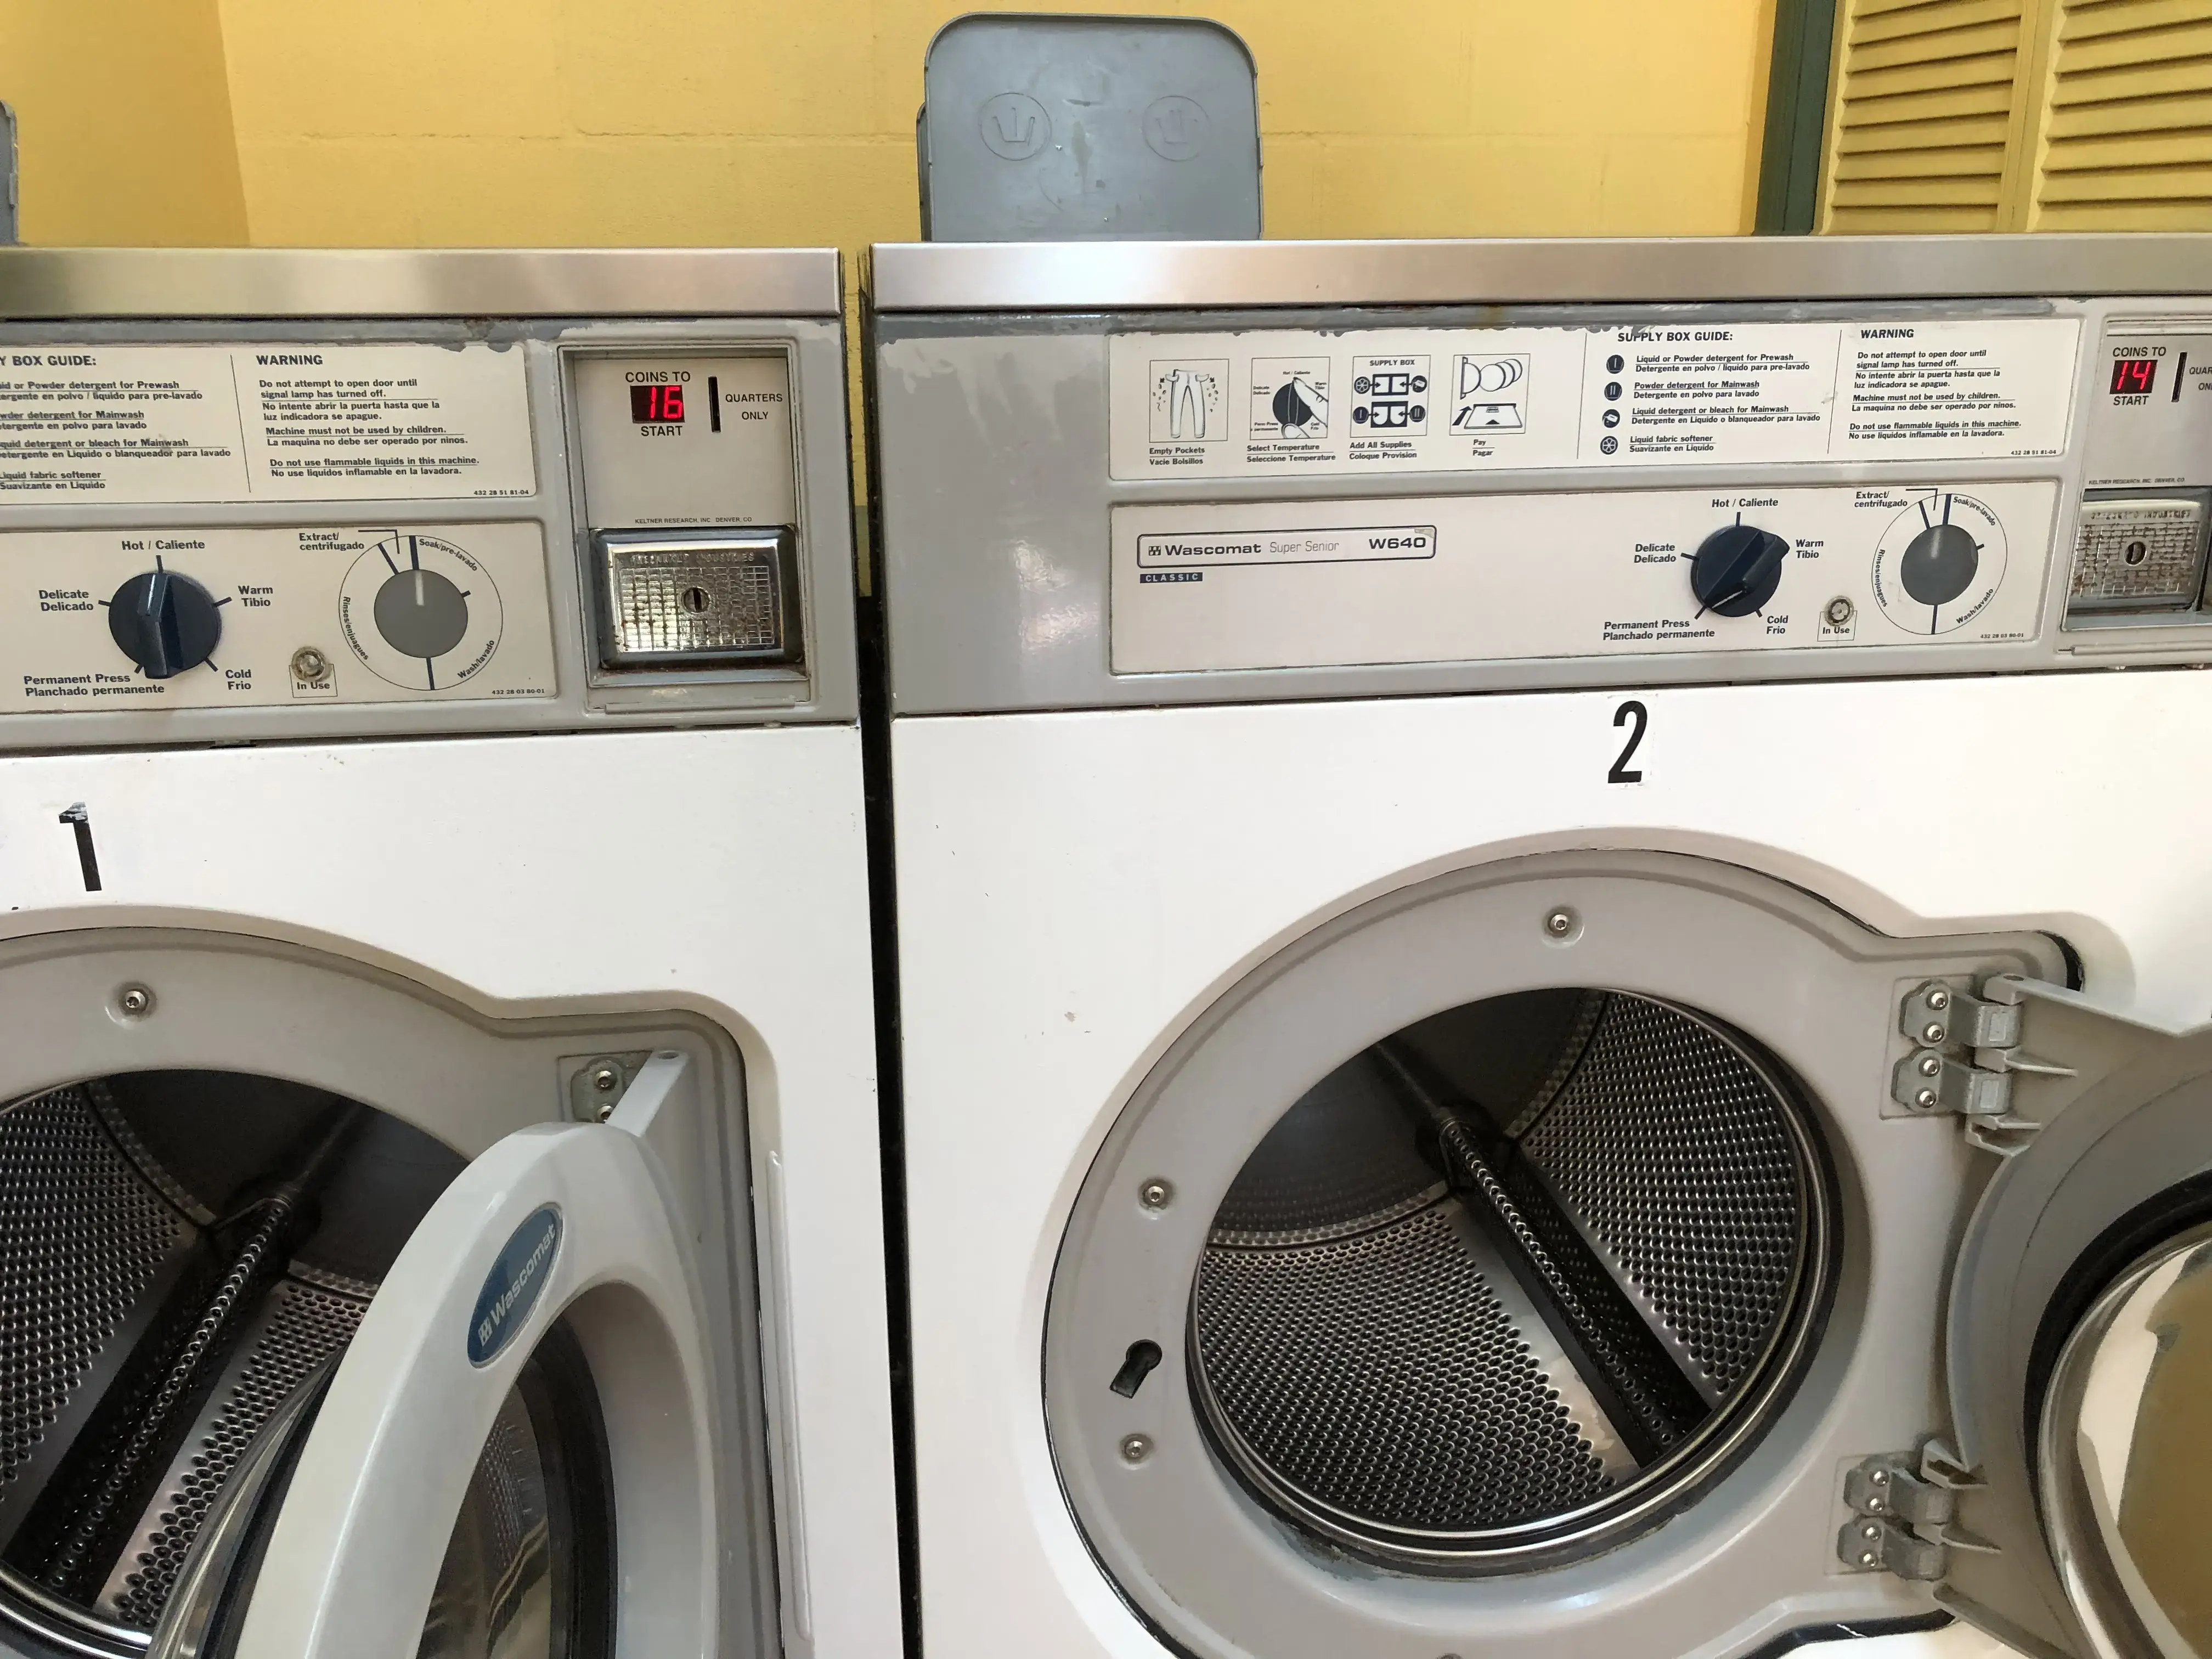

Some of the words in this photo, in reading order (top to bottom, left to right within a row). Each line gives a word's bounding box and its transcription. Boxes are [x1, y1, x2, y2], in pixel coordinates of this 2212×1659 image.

[1667, 332, 1690, 341] BOX
[1695, 331, 1733, 341] GUIDE:
[1861, 329, 1914, 338] WARNING
[2113, 346, 2148, 357] COINS
[2152, 346, 2166, 357] TO
[12, 355, 42, 366] BOX
[48, 355, 96, 366] GUIDE:
[256, 354, 323, 365] WARNING
[1637, 355, 1660, 365] Liquid
[1706, 354, 1743, 364] detergent
[1857, 361, 1878, 370] signal
[1918, 359, 1943, 368] turned
[625, 371, 668, 383] COINS
[672, 371, 690, 382] TO
[2117, 361, 2151, 390] 14
[27, 381, 65, 390] Powder
[69, 381, 117, 392] detergent
[120, 381, 134, 389] for
[137, 381, 179, 389] Prewash
[259, 380, 272, 388] Do
[295, 380, 331, 388] attempt
[1635, 382, 1664, 390] Powder
[1667, 381, 1705, 390] detergent
[1708, 381, 1718, 389] for
[1722, 380, 1759, 389] Mainwash
[261, 390, 288, 399] signal
[291, 390, 314, 399] lamp
[317, 390, 333, 398] has
[336, 390, 366, 398] turned
[370, 389, 386, 397] off.
[726, 393, 782, 403] QUARTERS
[650, 387, 683, 419] 16
[2113, 395, 2149, 406] START
[742, 411, 768, 420] ONLY
[266, 427, 305, 435] Machine
[368, 426, 390, 434] used
[393, 426, 403, 436] by
[407, 425, 446, 433] children.
[641, 425, 682, 437] START
[1936, 421, 1959, 431] liquids
[1380, 441, 1412, 449] Supplies
[1630, 436, 1653, 445] Liquid
[1630, 444, 1671, 453] Suavizante
[1674, 443, 1683, 452] en
[1686, 443, 1713, 452] Liquido
[1350, 451, 1380, 460] Coloque
[30, 471, 57, 479] fabric
[61, 471, 101, 479] softener
[1856, 490, 1889, 499] Extract/
[1712, 499, 1729, 508] Hot
[1739, 498, 1778, 507] Caliente
[1854, 499, 1908, 509] centrifugado
[1953, 496, 1995, 527] Soak/pre-lavado
[299, 532, 339, 541] Extract/
[122, 540, 144, 550] Hot
[156, 540, 205, 550] Caliente
[300, 541, 364, 551] centrifugado
[1270, 542, 1301, 555] Super
[1306, 541, 1339, 552] Senior
[1369, 537, 1426, 549] W640
[1635, 543, 1675, 552] Delicate
[1796, 539, 1824, 548] Warm
[419, 538, 478, 572] Soak/pre-lavado
[1165, 544, 1261, 556] Wascomat
[1796, 550, 1819, 558] Tibio
[1634, 554, 1676, 563] Delicado
[1146, 572, 1198, 582] CLASSIC
[1875, 549, 1888, 607] Rinses/enjuagues
[39, 589, 89, 599] Delicate
[238, 585, 273, 595] Warm
[41, 601, 93, 612] Delicado
[241, 597, 270, 607] Tibio
[1956, 588, 1994, 624] Wash/lavado
[1604, 620, 1658, 630] Permanent
[1662, 619, 1690, 628] Press
[1767, 615, 1788, 624] Cold
[343, 596, 369, 661] Rinses/enjuagues
[1767, 625, 1785, 634] Frio
[1834, 626, 1849, 634] Use
[1603, 630, 1653, 641] Planchado
[1657, 629, 1714, 640] permanente
[457, 640, 495, 679] Wash/lavado
[225, 669, 251, 679] Cold
[24, 674, 91, 685] Permanent
[95, 674, 131, 683] Press
[228, 681, 251, 690] Frio
[310, 680, 330, 690] Use
[25, 686, 88, 697] Planchado
[93, 684, 164, 697] permanente
[1607, 700, 1647, 783] 2
[59, 802, 102, 891] 1
[490, 1223, 555, 1325] Wascomat
